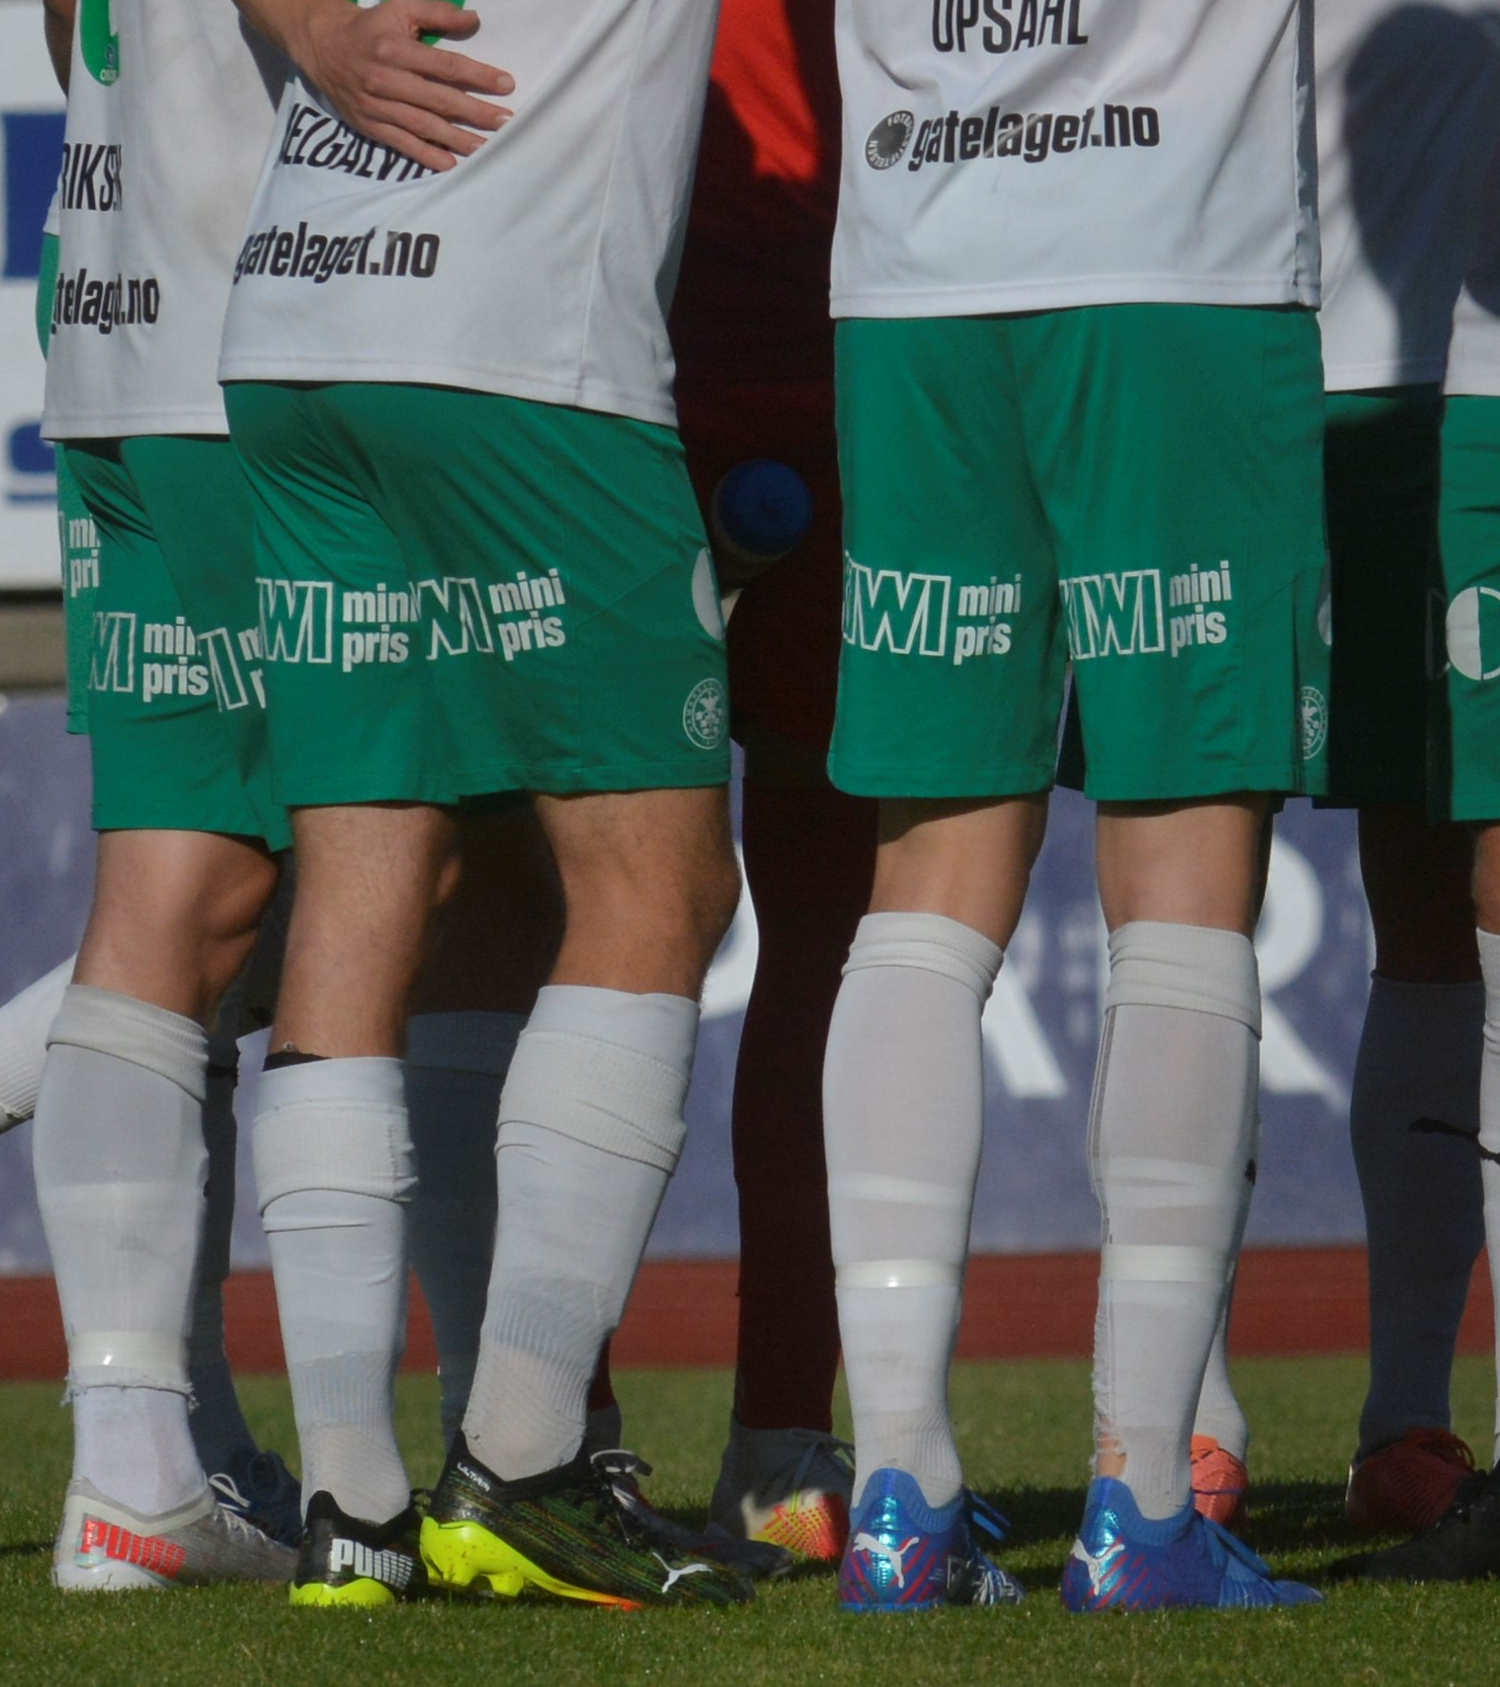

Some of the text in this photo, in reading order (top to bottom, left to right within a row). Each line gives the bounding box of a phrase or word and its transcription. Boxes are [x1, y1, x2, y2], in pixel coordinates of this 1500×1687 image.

[907, 103, 1161, 173] gatelaget.no
[233, 221, 441, 286] gatelaget.no
[69, 548, 100, 598] pri
[487, 567, 566, 615] mini
[958, 573, 1022, 617] mini
[1168, 559, 1233, 608] mini
[342, 623, 410, 673] pris
[497, 610, 566, 662] pris
[953, 616, 1012, 665] pris
[1169, 605, 1229, 658] pris
[142, 656, 210, 703] pris
